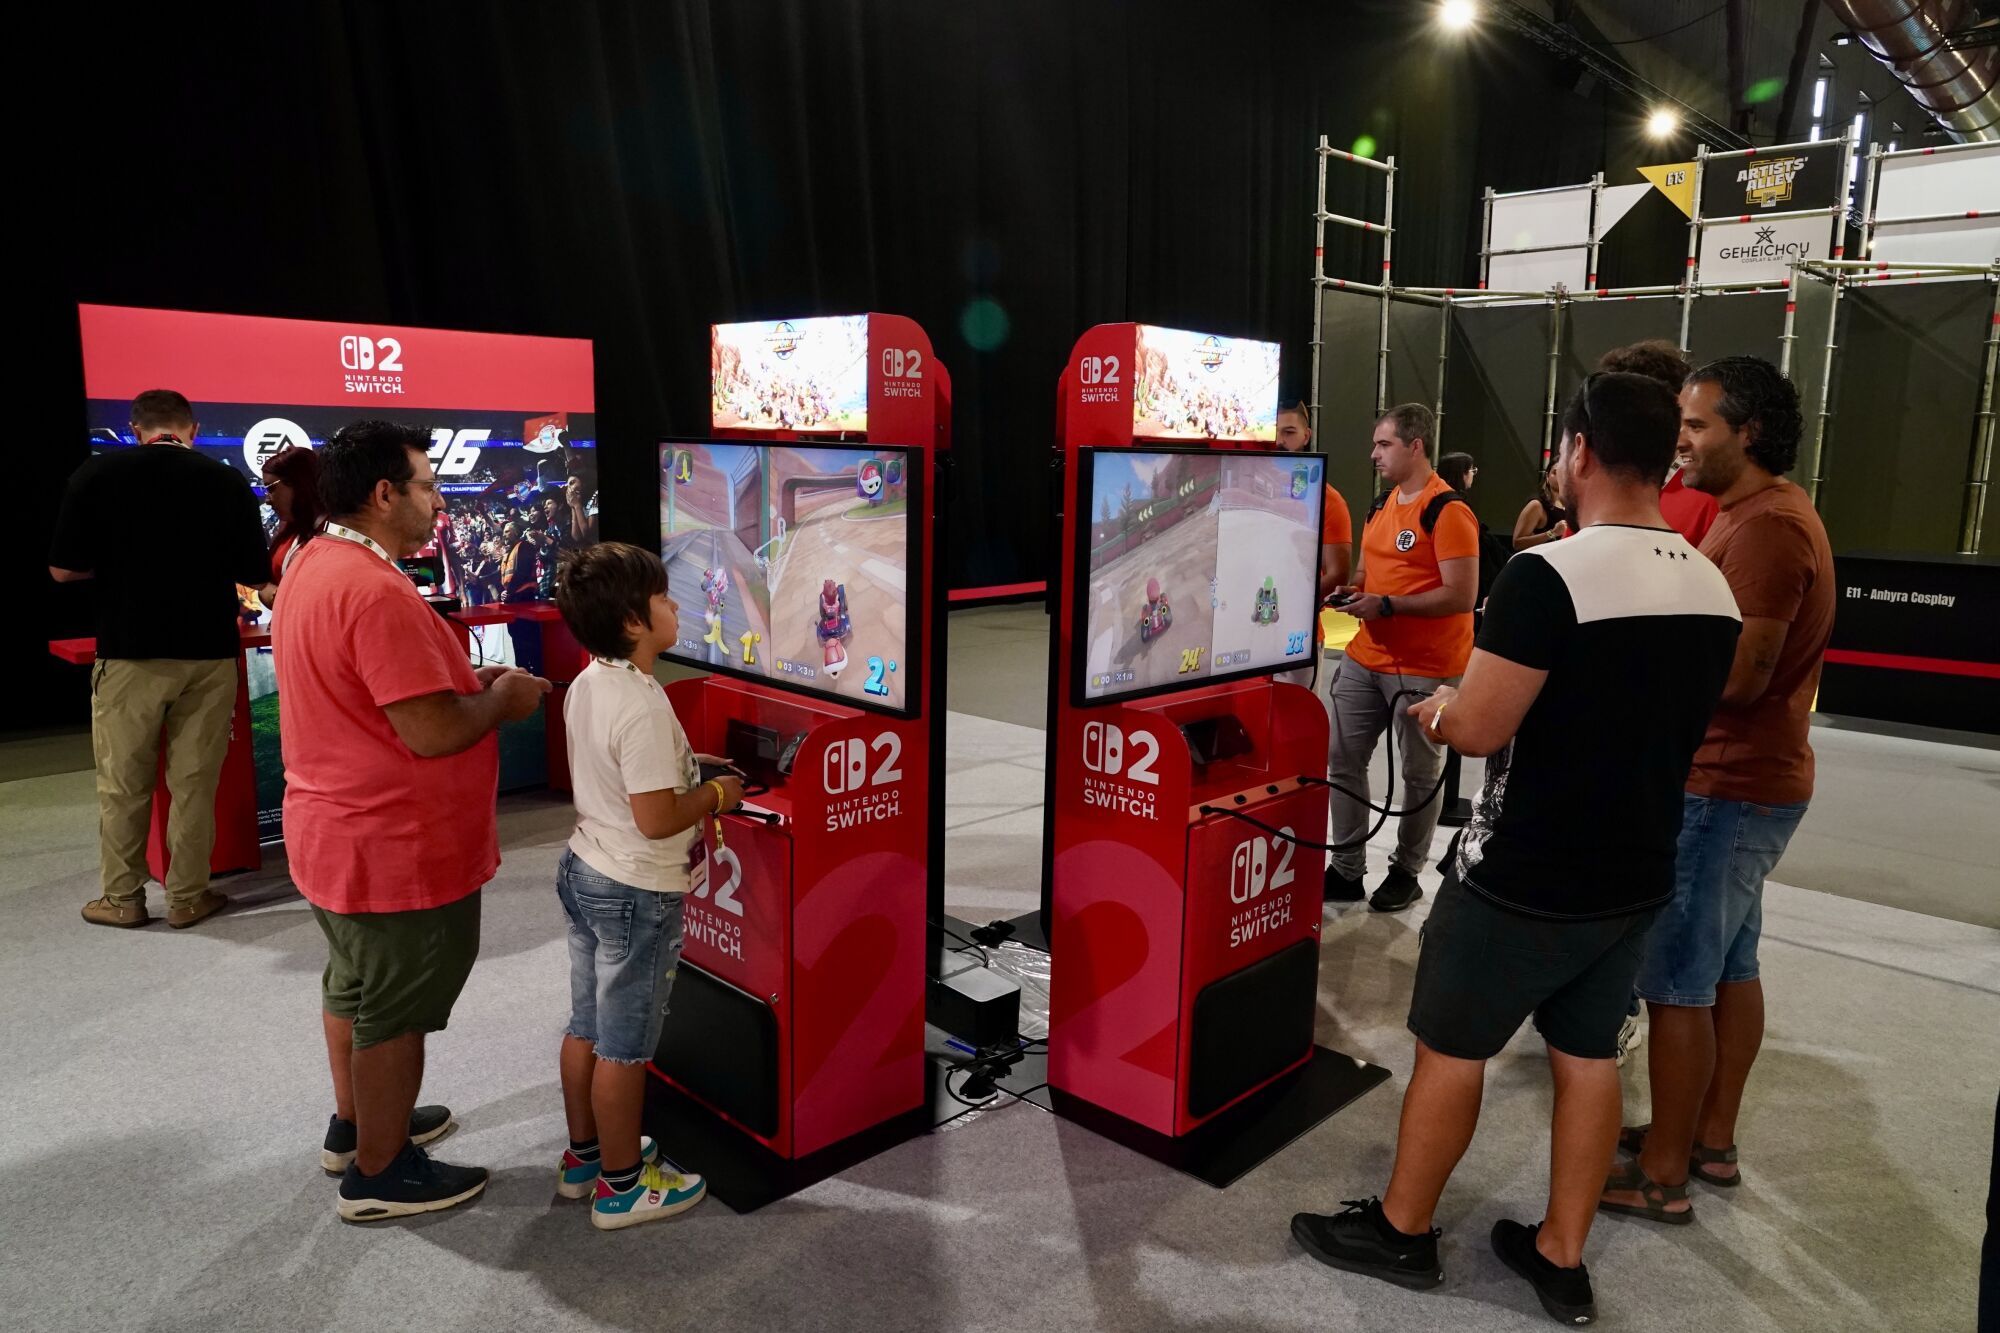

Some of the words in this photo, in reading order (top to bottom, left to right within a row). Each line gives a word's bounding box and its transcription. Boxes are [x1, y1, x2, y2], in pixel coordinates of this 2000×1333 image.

[1666, 170, 1685, 186] E13
[1746, 171, 1796, 191] ALLEY
[344, 374, 402, 383] NINTENDO
[345, 381, 402, 394] SWITCH
[884, 387, 921, 398] SWITCH
[1081, 393, 1118, 403] SWITCH
[257, 433, 296, 454] EA
[1846, 587, 1861, 598] E11
[1870, 588, 1908, 603] Anhyra
[1911, 591, 1956, 607] Cosplay
[1084, 778, 1155, 802] NINTENDO
[826, 789, 900, 814] NINTENDO
[1083, 789, 1155, 820] SWITCH
[826, 800, 900, 832] SWITCH
[685, 903, 741, 937] INTENDO
[1231, 893, 1292, 927] NINTENDO
[1230, 907, 1291, 948] SWITCH
